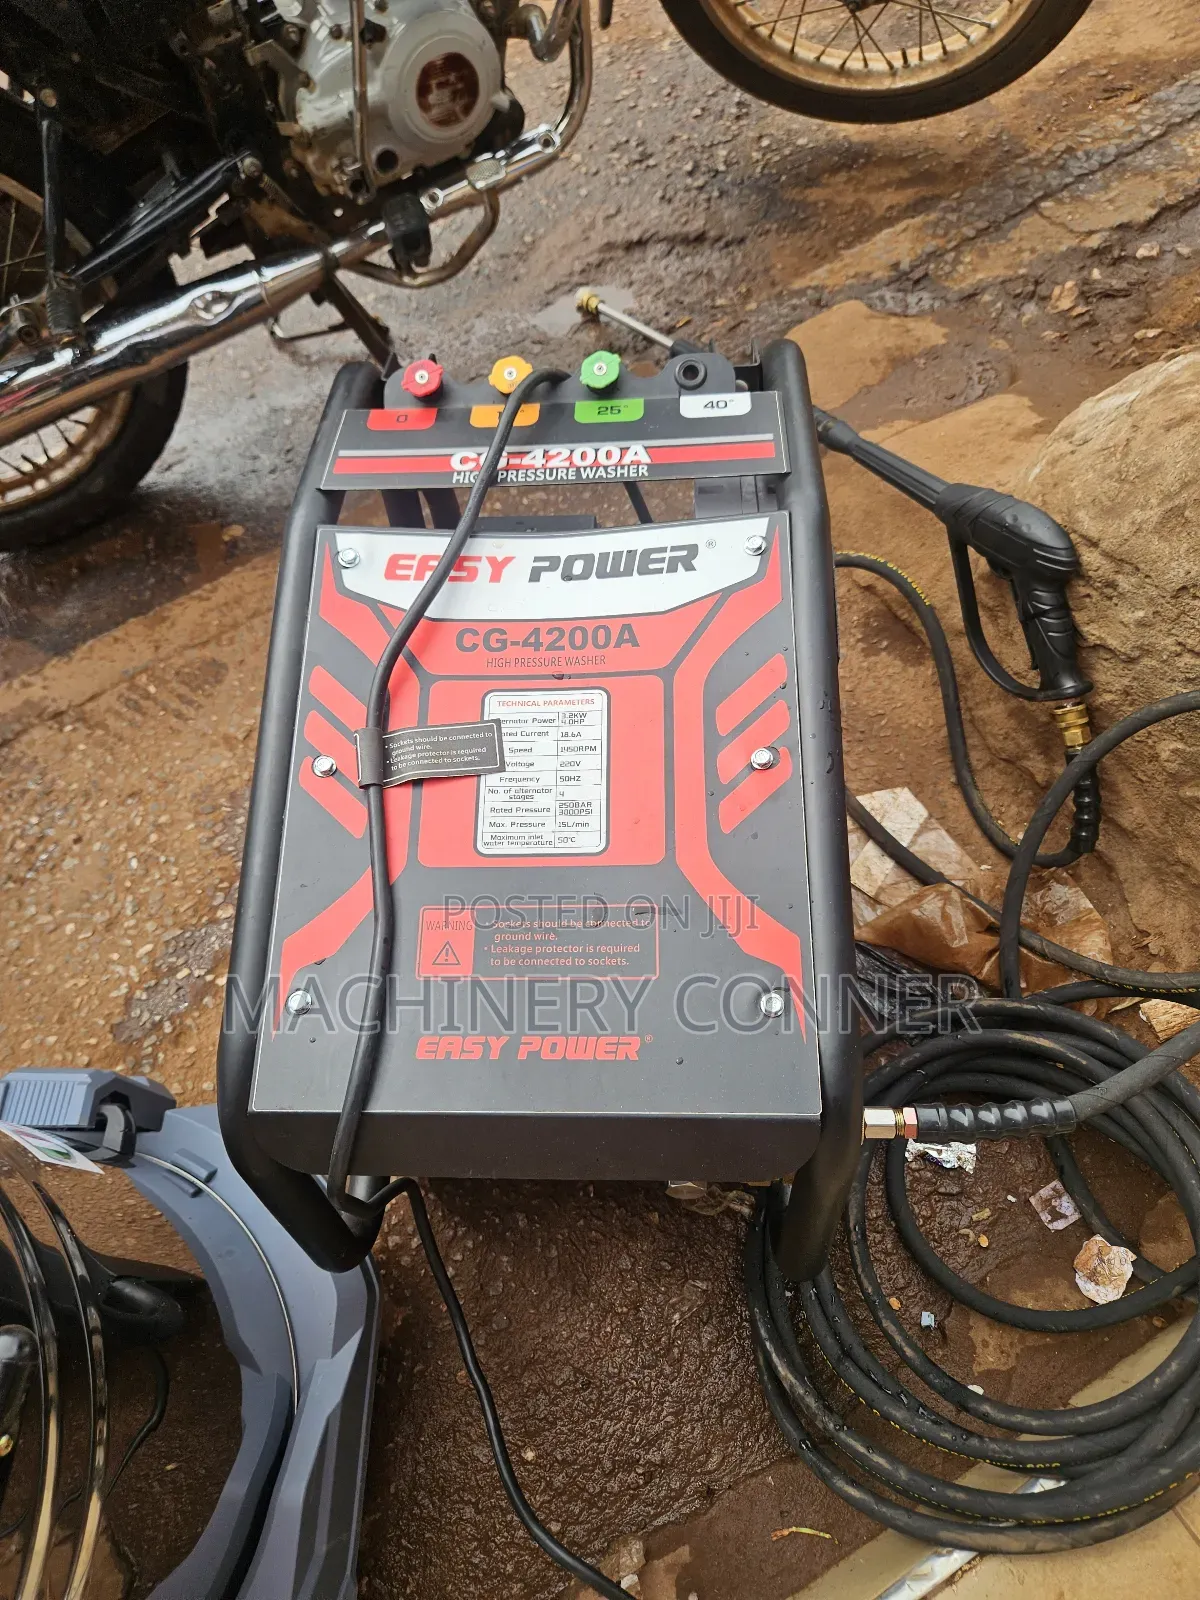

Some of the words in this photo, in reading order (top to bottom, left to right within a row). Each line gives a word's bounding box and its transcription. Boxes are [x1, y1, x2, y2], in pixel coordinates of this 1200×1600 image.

[452, 471, 483, 484] HIG
[497, 468, 577, 482] PRESSURE
[580, 464, 649, 480] WASHER
[528, 543, 699, 583] POWER
[455, 623, 641, 653] CG-4200A
[486, 657, 512, 668] HIGH
[514, 656, 563, 668] PRESSURE
[564, 655, 606, 667] WASHER
[543, 698, 595, 707] PARAMETERS
[531, 717, 557, 725] Power
[520, 730, 550, 738] Current
[389, 738, 414, 749] Sockets
[414, 735, 438, 743] should
[448, 731, 484, 741] connected
[390, 753, 417, 764] Leakage
[417, 750, 450, 758] protector
[457, 746, 487, 755] required
[391, 744, 415, 758] ground
[508, 746, 533, 754] Speed
[407, 757, 443, 766] connected
[452, 755, 481, 763] sockets.
[505, 760, 535, 769] Voltage
[559, 760, 582, 768] 220V
[499, 776, 541, 784] Frequency
[490, 806, 513, 814] Rated
[558, 801, 593, 809] 250BAR
[426, 920, 473, 931] WARNING
[492, 919, 531, 928] Sockets
[533, 919, 568, 928] should
[570, 919, 583, 928] be
[585, 919, 638, 928] connected
[641, 919, 651, 927] to
[494, 931, 531, 943] ground
[533, 931, 558, 941] wire.
[490, 944, 533, 955] Leakage
[535, 943, 584, 955] protector
[586, 943, 594, 953] is
[596, 943, 641, 954] required
[490, 957, 501, 966] to
[503, 956, 516, 966] be
[518, 956, 573, 966] connected
[574, 956, 586, 966] to
[588, 955, 630, 966] sockets.
[415, 1036, 510, 1060] EASY
[517, 1036, 641, 1061] POWER
